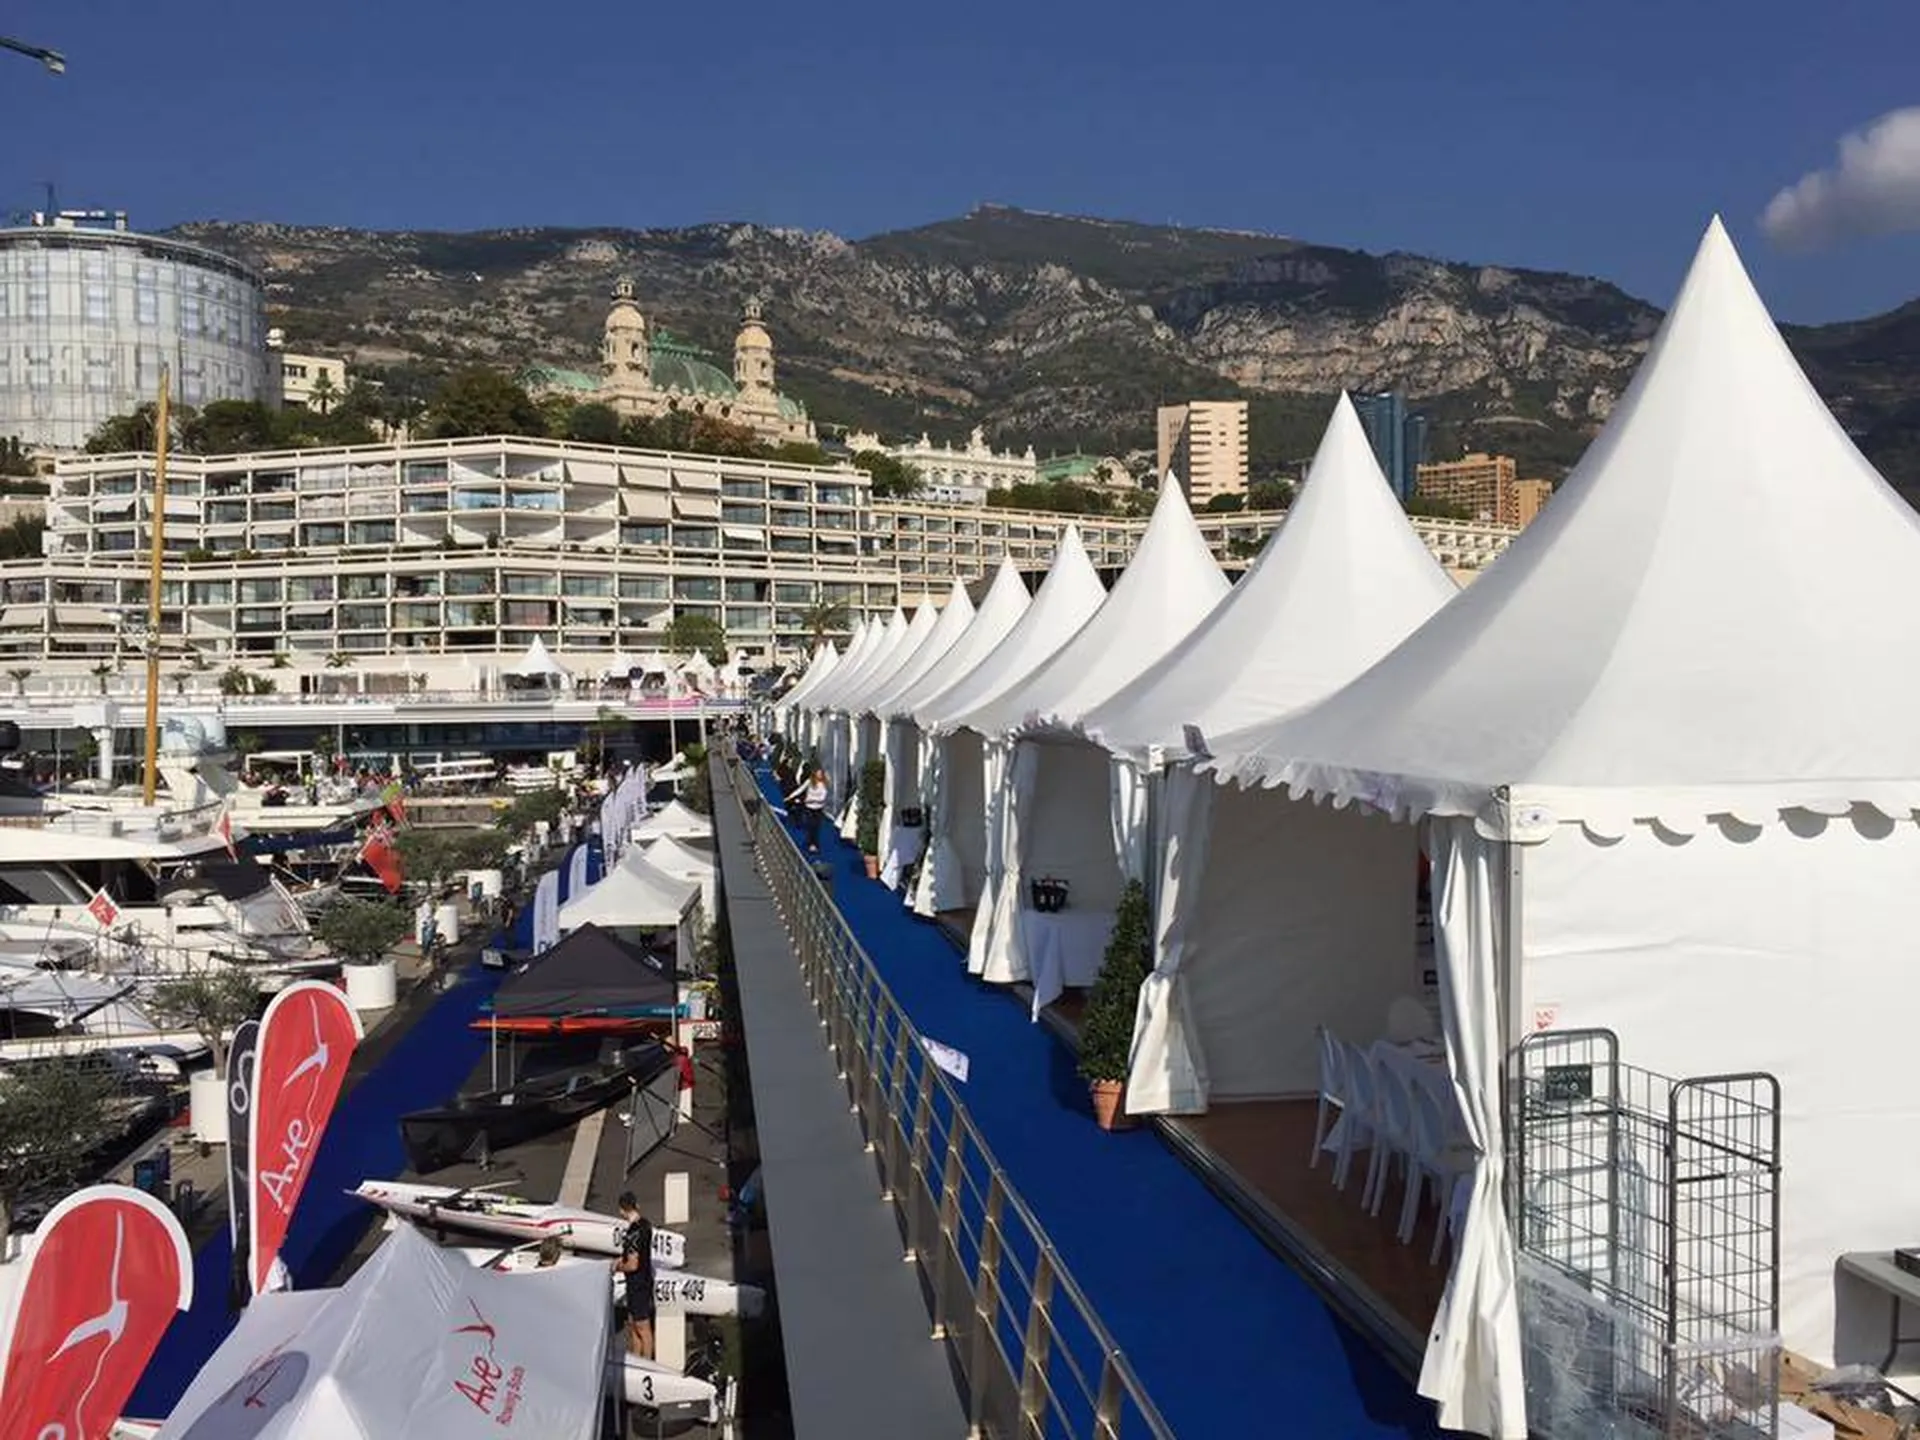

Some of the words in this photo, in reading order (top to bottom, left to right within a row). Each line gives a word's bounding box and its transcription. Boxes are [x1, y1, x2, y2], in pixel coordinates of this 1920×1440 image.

[651, 1233, 673, 1256] 415
[454, 1356, 503, 1414] Ave
[642, 1375, 654, 1401] 3
